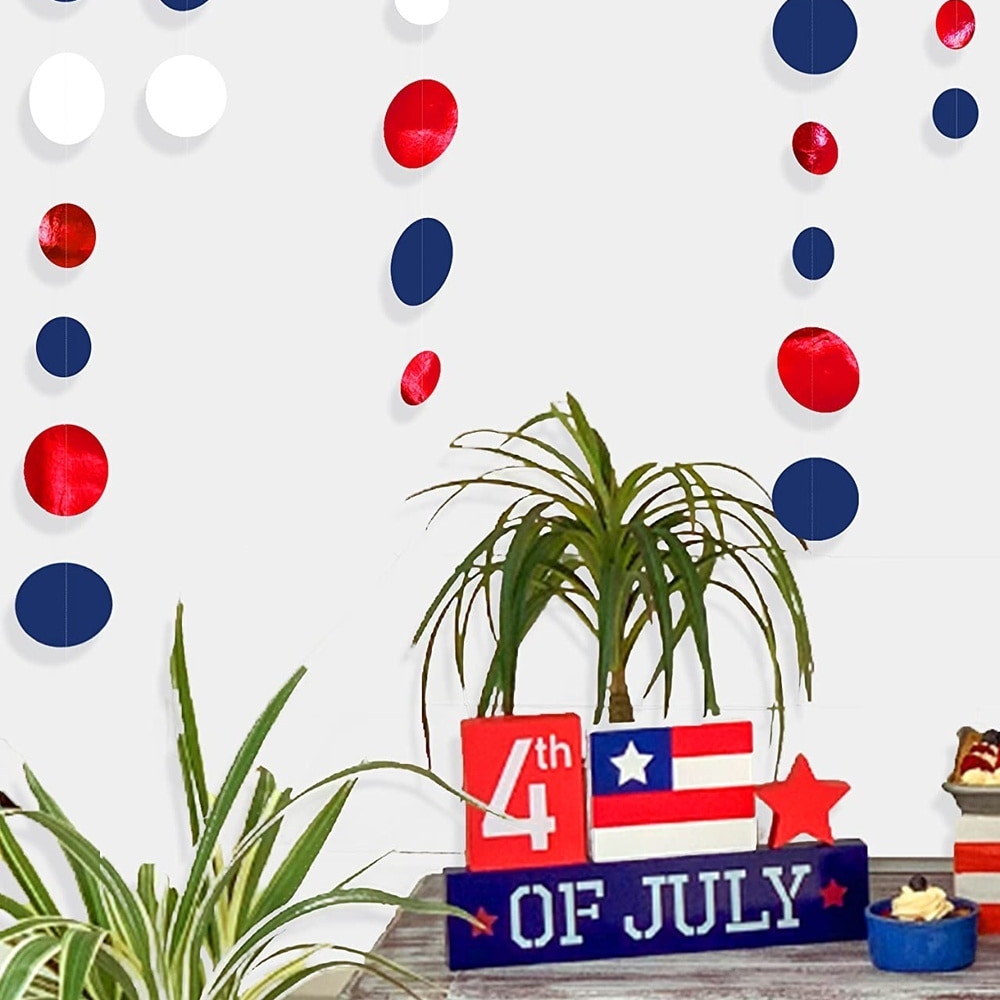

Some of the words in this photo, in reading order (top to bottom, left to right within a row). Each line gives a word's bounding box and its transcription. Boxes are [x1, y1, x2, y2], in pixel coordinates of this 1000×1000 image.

[482, 734, 573, 851] 4th
[509, 880, 604, 949] OF
[624, 864, 812, 940] JULY
